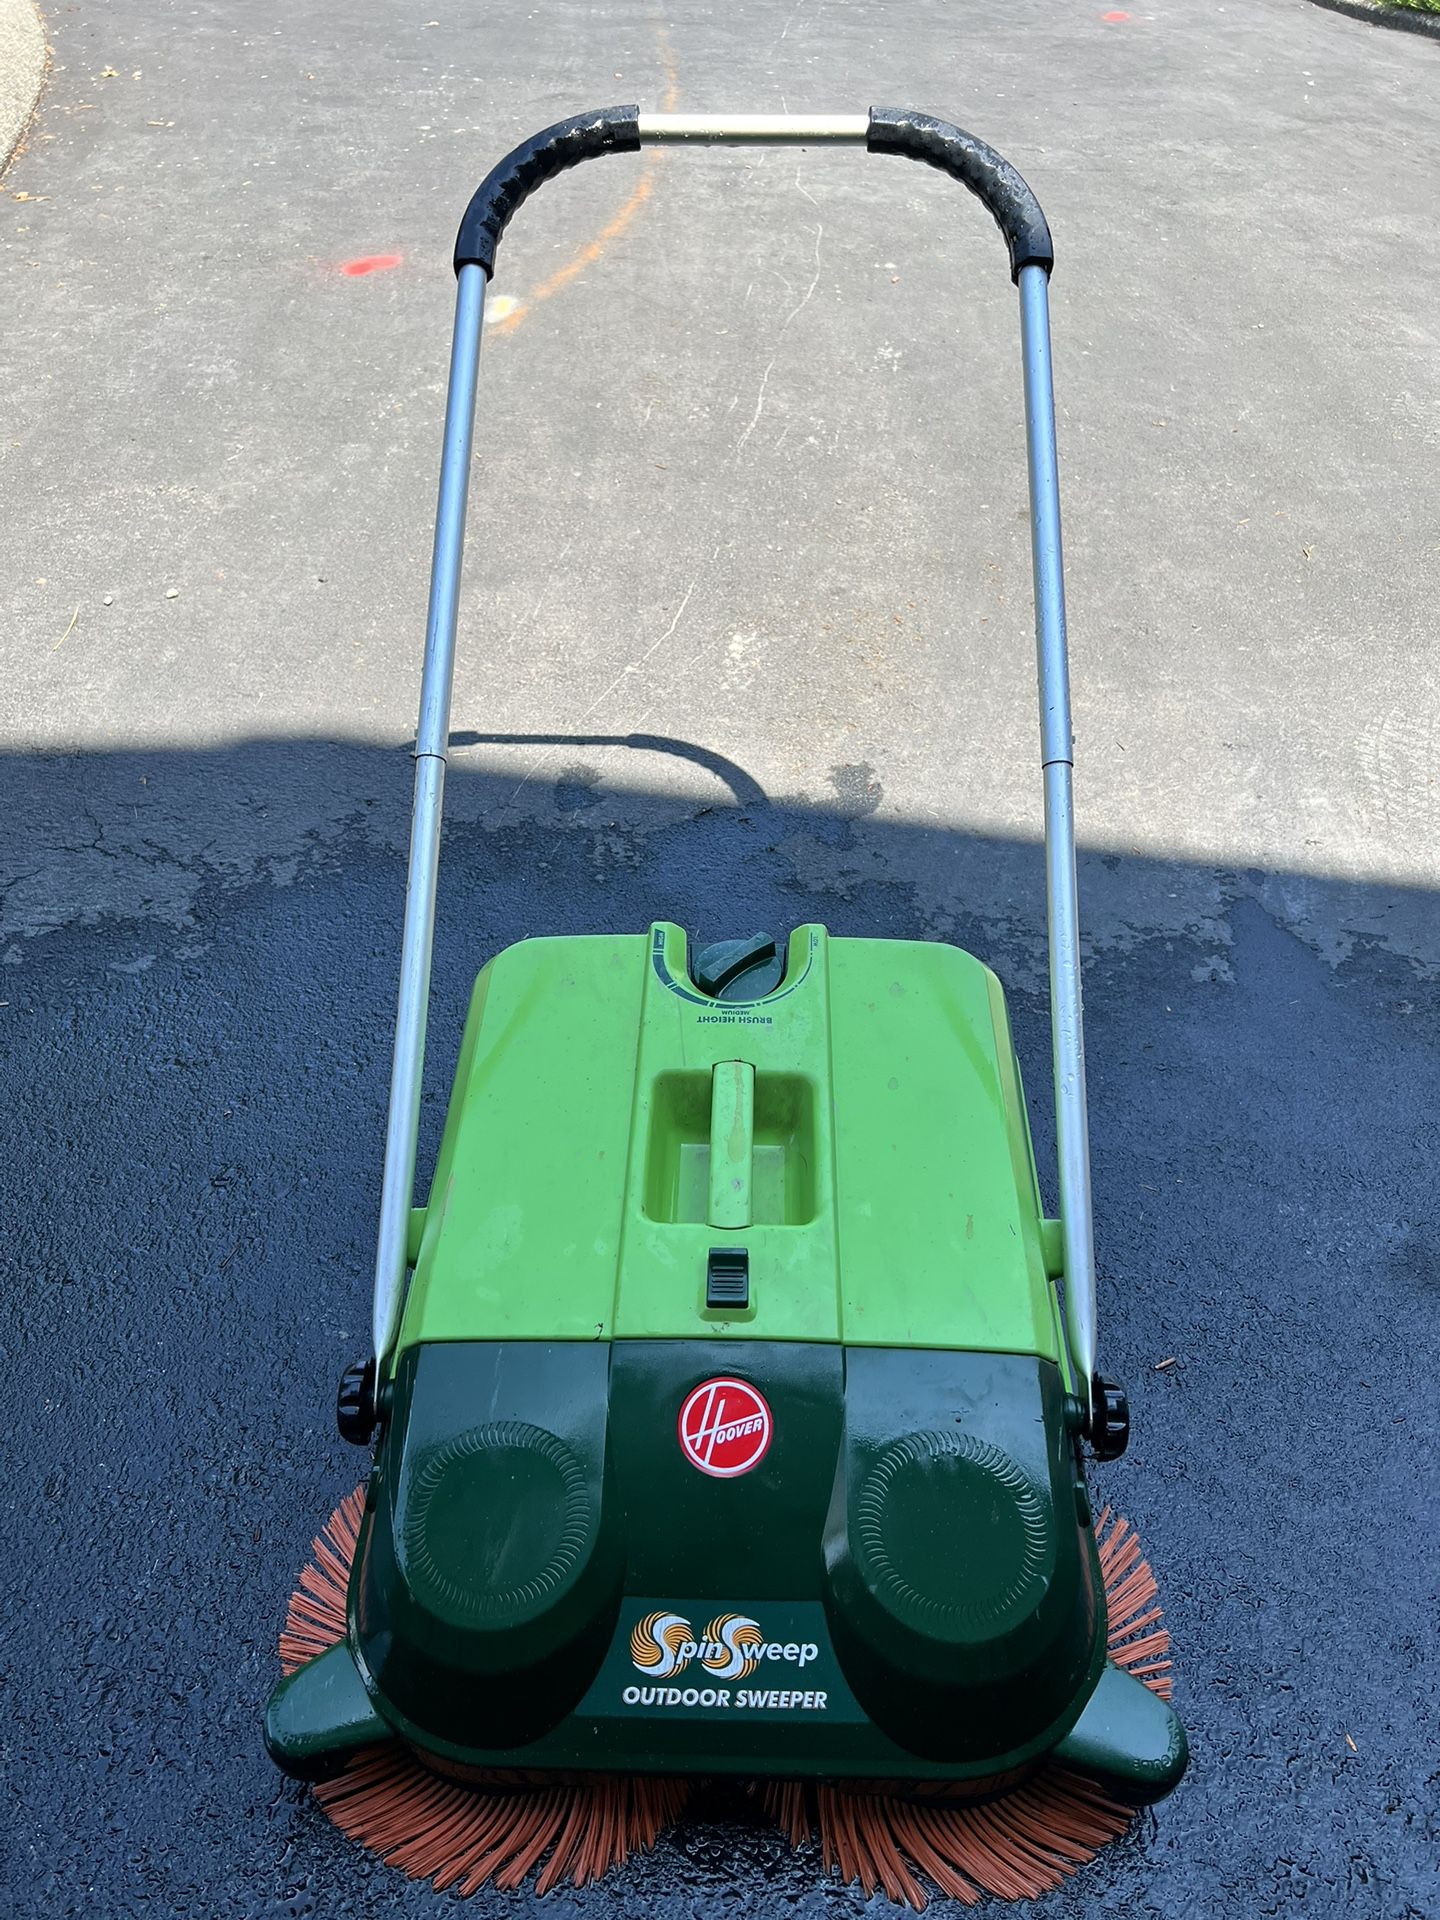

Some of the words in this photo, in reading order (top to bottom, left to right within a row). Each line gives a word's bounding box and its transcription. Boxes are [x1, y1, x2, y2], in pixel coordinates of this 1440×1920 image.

[696, 1015, 735, 1024] HEIGHT
[738, 1016, 773, 1024] BRUSH
[684, 1384, 764, 1467] HOOVER
[622, 1686, 731, 1708] OUTDOOR
[734, 1689, 828, 1710] SWEEPER
